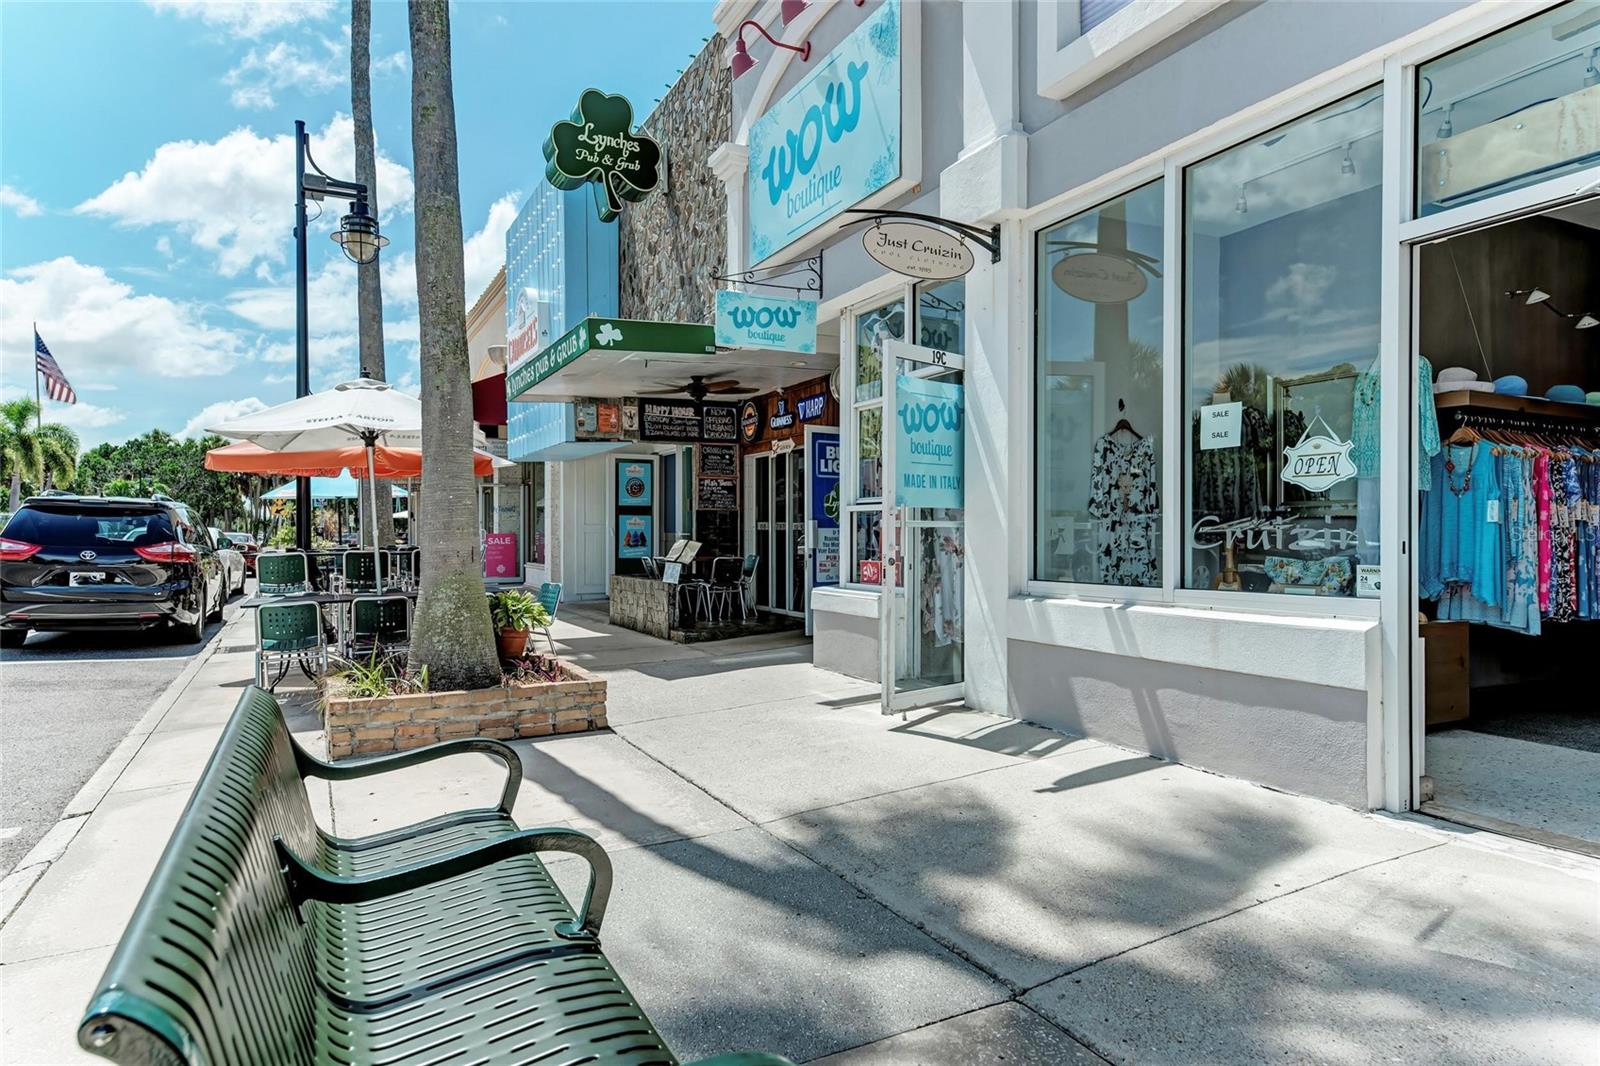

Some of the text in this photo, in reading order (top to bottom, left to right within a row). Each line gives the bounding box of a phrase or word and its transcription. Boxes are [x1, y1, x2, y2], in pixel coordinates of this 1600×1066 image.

[578, 123, 640, 157] Lynches
[762, 61, 868, 205] wow
[576, 148, 640, 171] Pub & Grub
[786, 164, 842, 219] boutique
[877, 232, 962, 260] Just Cruizin
[727, 306, 801, 329] wow
[748, 329, 785, 343] boutique
[550, 349, 555, 367] &
[556, 334, 577, 365] GRUB
[932, 350, 947, 365] 19C
[645, 404, 695, 416] HAPPY HOUR
[805, 397, 824, 418] HARP
[898, 402, 964, 434] wow
[1212, 410, 1229, 418] SALE
[770, 414, 793, 429] GUINNESS
[1211, 431, 1229, 439] SALE
[910, 438, 953, 461] boutique
[1294, 456, 1342, 477] OPEN
[904, 473, 961, 490] MADE IN ITALY
[487, 537, 511, 545] SALE
